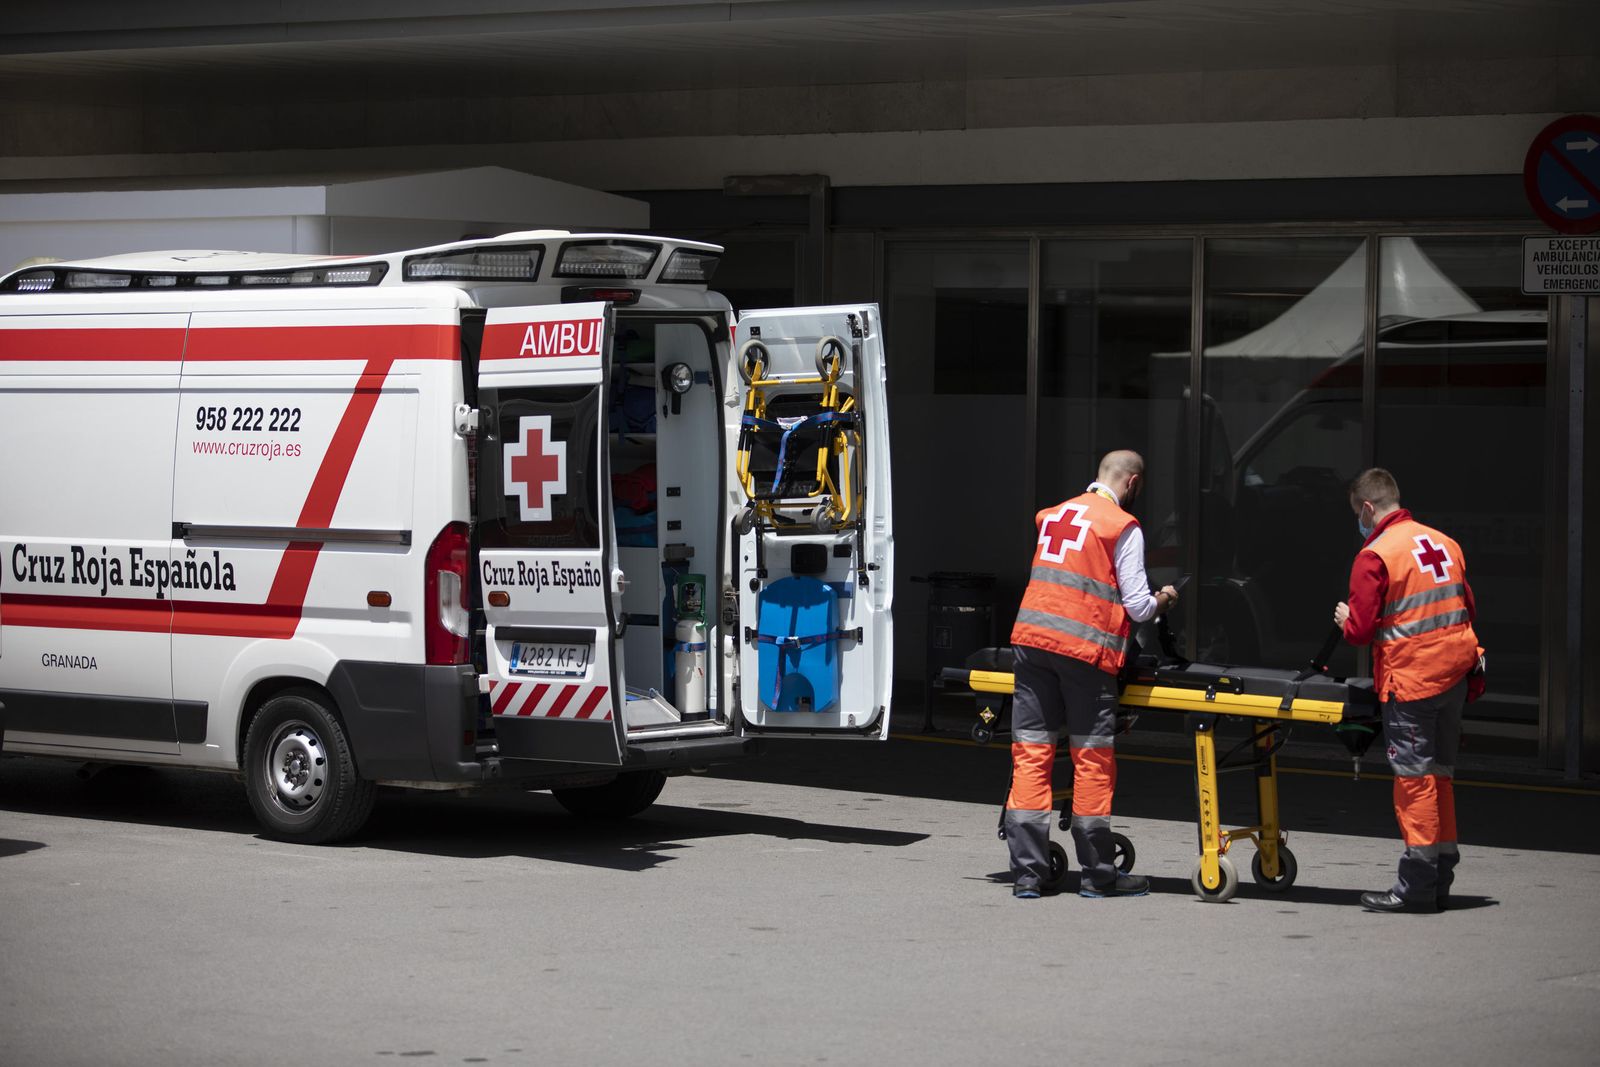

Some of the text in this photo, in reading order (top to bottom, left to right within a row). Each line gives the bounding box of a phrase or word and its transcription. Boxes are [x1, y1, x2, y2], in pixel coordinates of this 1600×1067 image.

[1543, 278, 1600, 290] EMERGENC
[195, 405, 302, 432] 958 222 222
[192, 439, 302, 461] www.cruzroja.es
[12, 542, 237, 600] Cruz Roja Española
[483, 559, 601, 594] Cruz Roja Españo
[41, 652, 98, 670] GRANADA
[520, 647, 587, 668] 4282 KFJ
